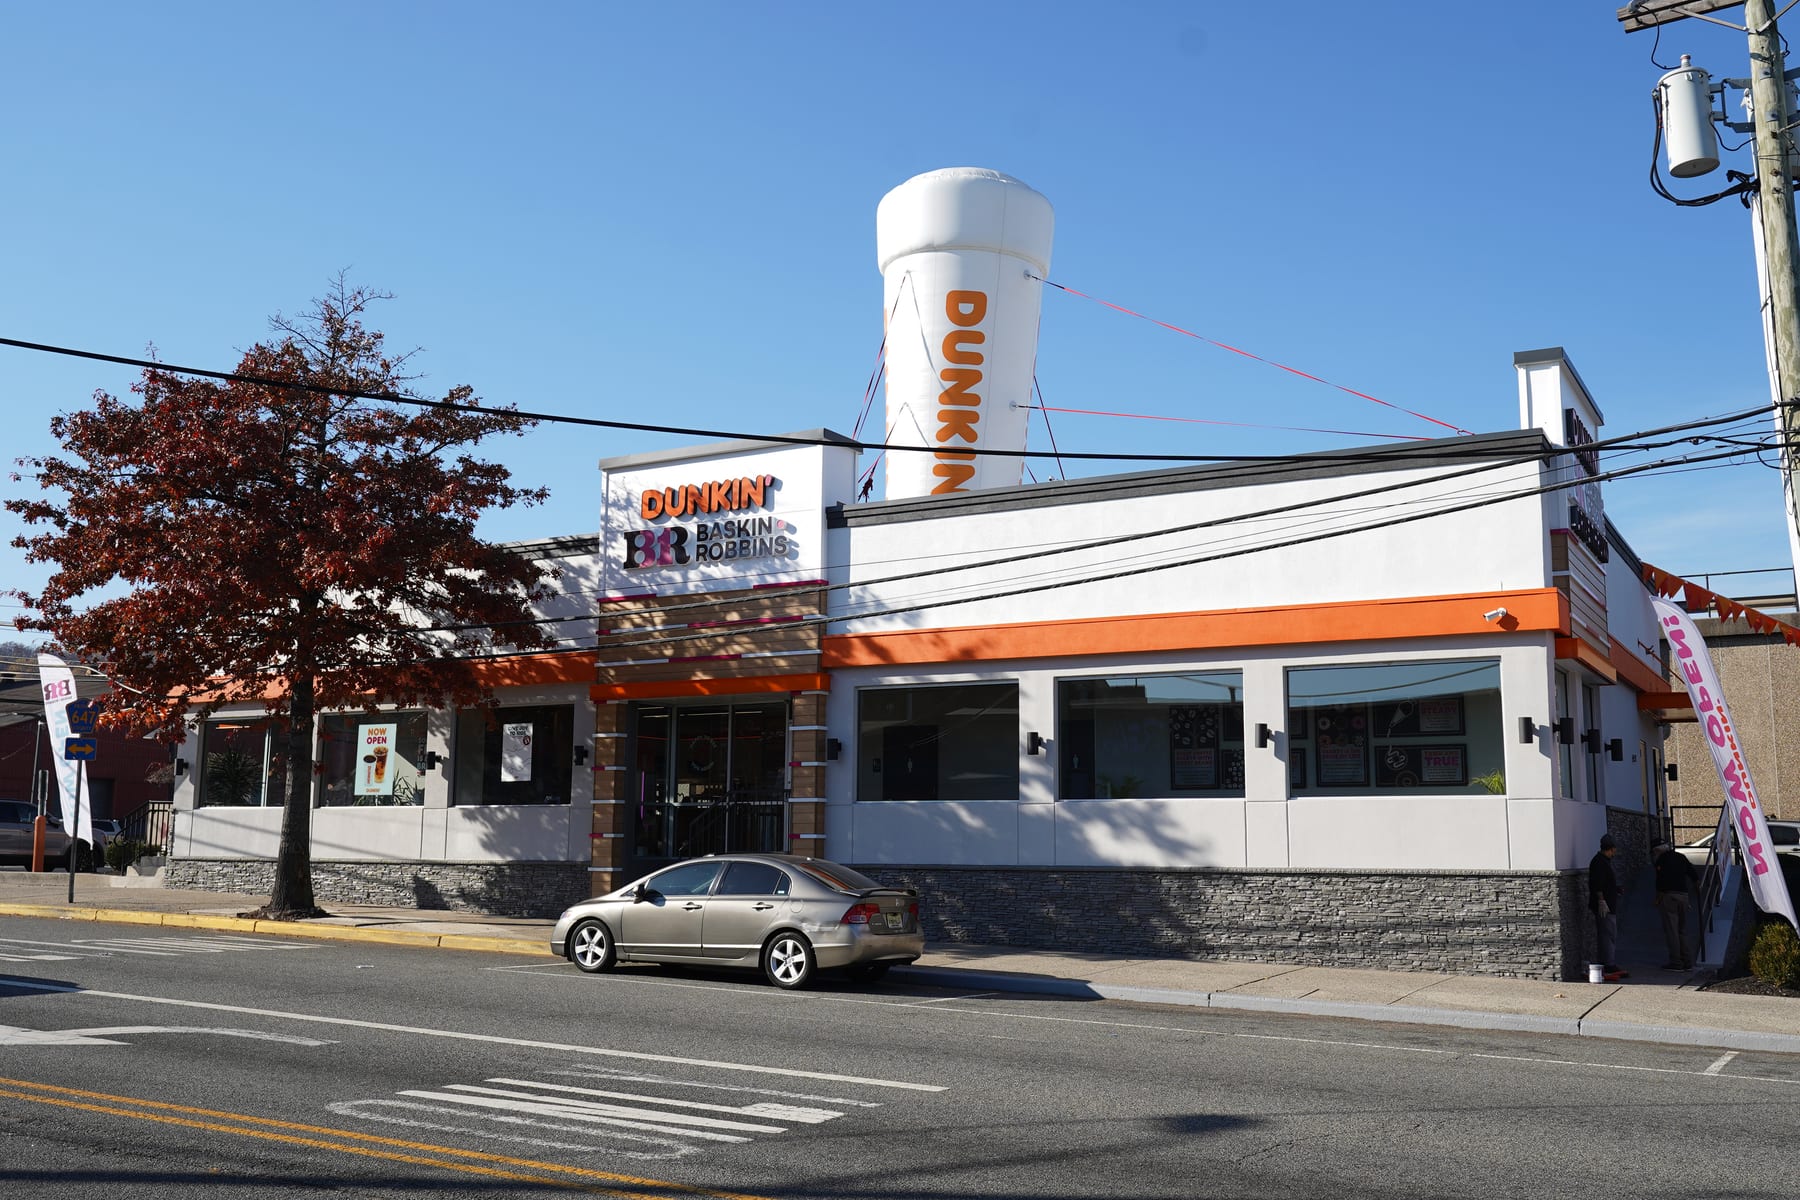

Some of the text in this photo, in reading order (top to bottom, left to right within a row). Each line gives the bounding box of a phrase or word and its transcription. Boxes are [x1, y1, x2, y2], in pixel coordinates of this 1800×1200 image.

[641, 474, 773, 520] DUNKIN'
[697, 516, 773, 542] BASKIN
[623, 526, 691, 569] BR
[696, 535, 788, 562] ROBBINS
[72, 711, 96, 724] 647
[367, 728, 387, 736] NOW
[1424, 756, 1459, 767] TRUE
